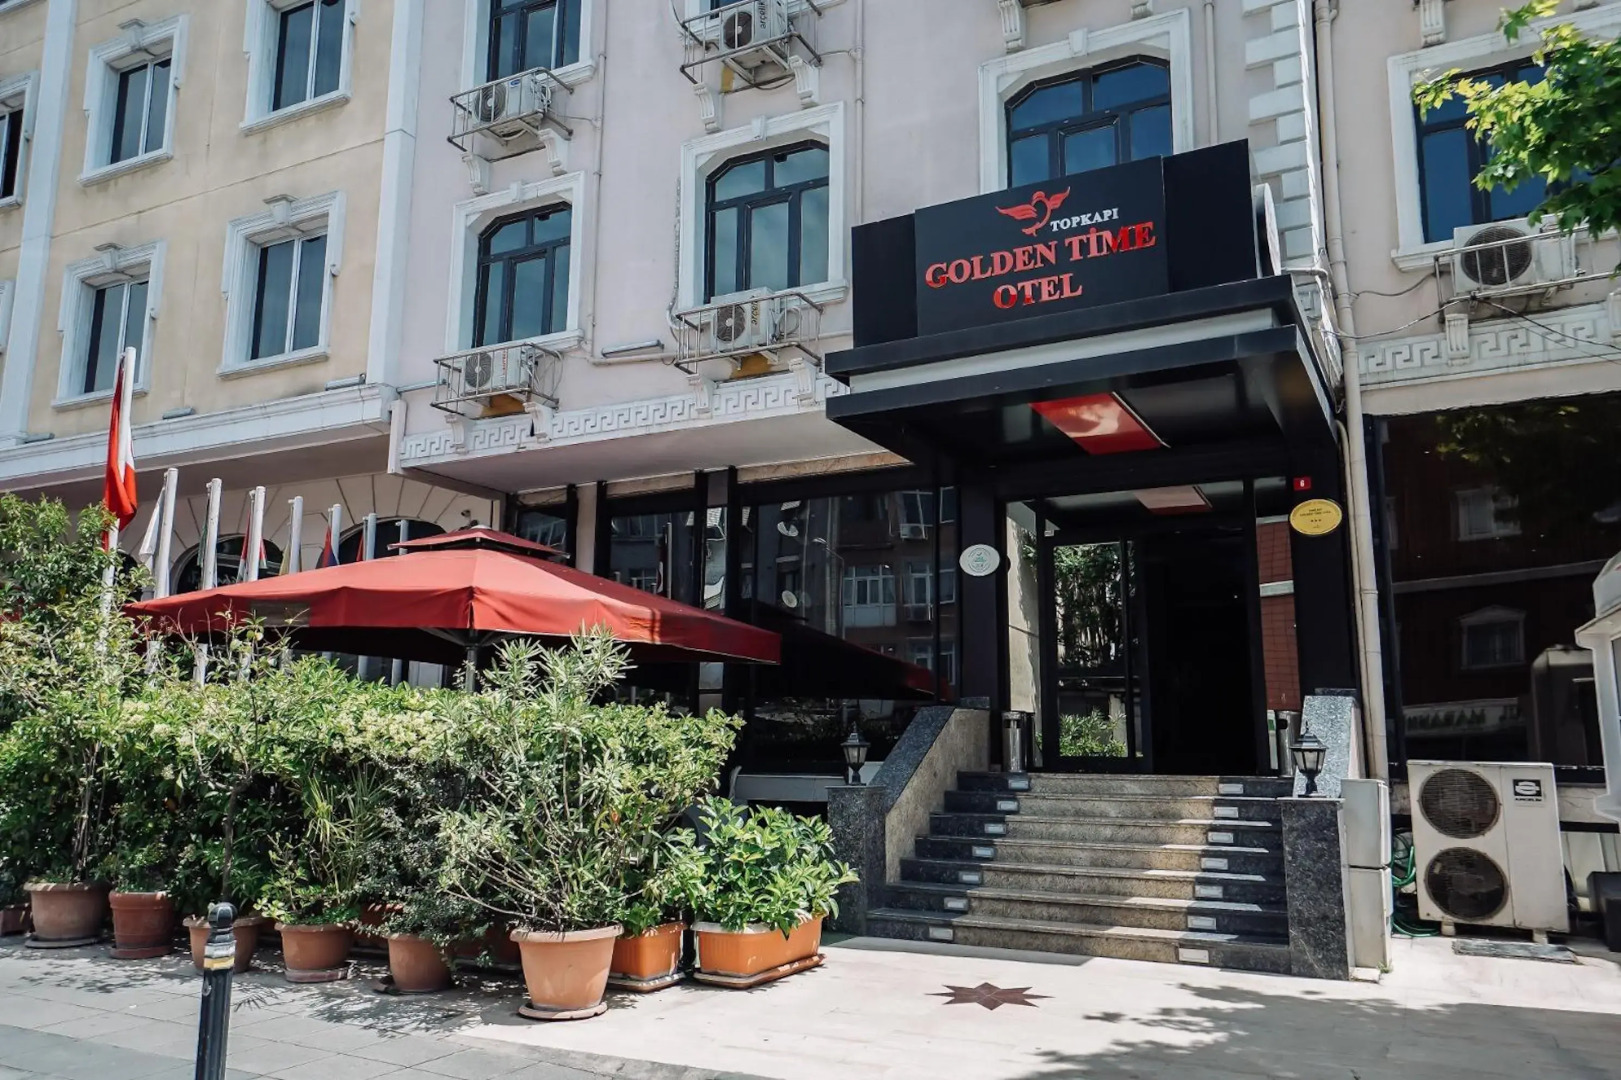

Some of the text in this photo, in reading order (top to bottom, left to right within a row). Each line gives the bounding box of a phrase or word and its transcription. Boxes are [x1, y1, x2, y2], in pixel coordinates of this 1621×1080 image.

[1050, 207, 1119, 232] TOPKAPI
[925, 221, 1156, 288] GOLDEN TİME
[993, 273, 1083, 309] OTEL
[1299, 479, 1305, 488] 6
